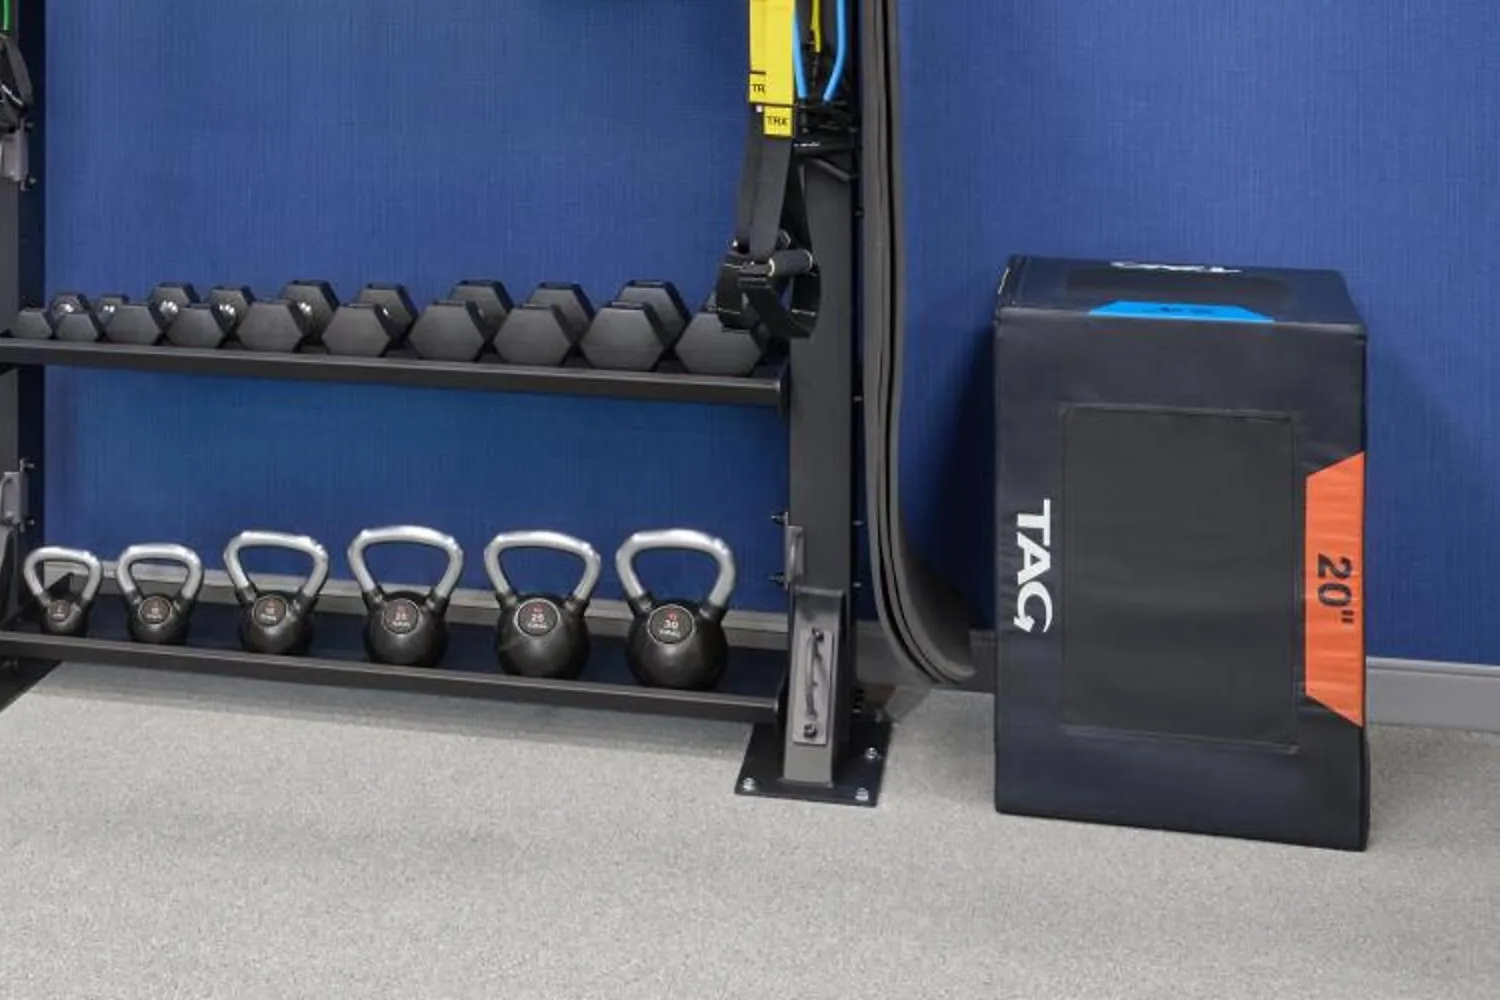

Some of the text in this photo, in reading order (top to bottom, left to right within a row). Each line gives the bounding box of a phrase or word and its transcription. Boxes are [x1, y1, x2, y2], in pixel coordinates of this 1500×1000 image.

[752, 83, 766, 94] TR
[1013, 499, 1053, 632] TAG
[1317, 552, 1354, 624] 20"
